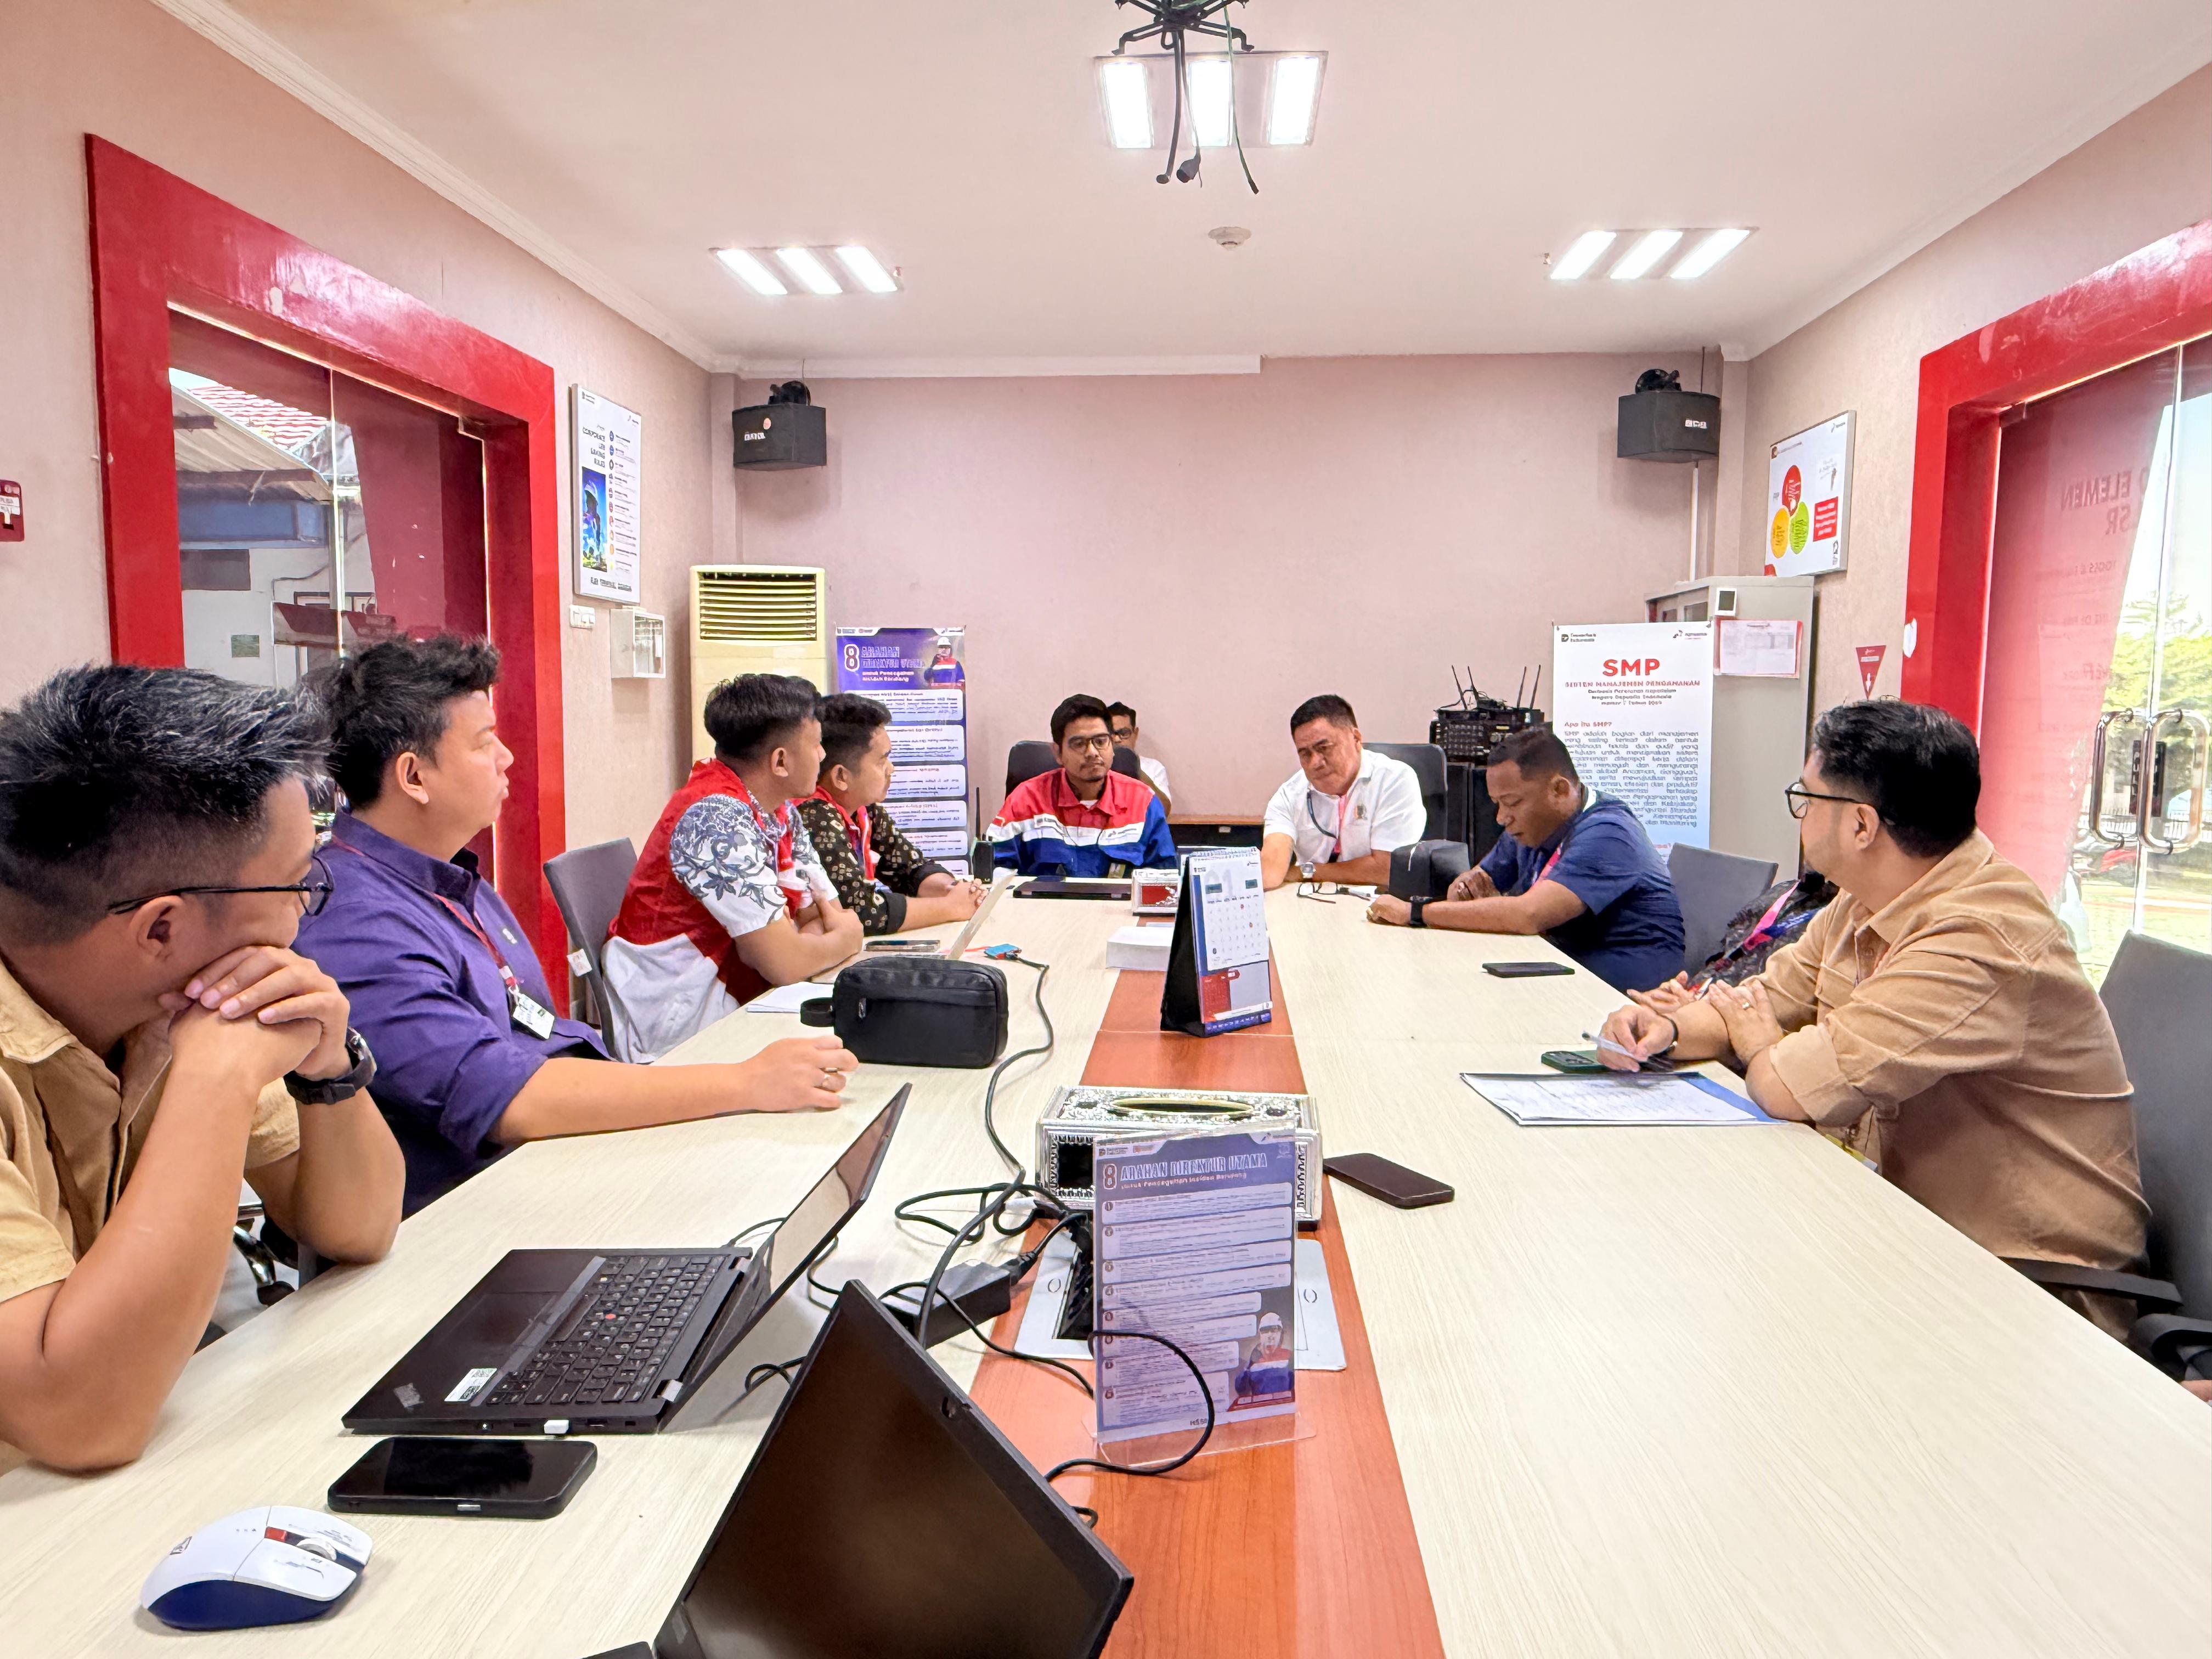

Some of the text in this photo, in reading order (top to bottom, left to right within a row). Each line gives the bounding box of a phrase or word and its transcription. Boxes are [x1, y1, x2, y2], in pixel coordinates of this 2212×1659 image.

[844, 644, 860, 672] 8
[1602, 659, 1660, 676] SMP
[1103, 1164, 1118, 1189] 8
[1121, 1161, 1167, 1181] ARAHAN
